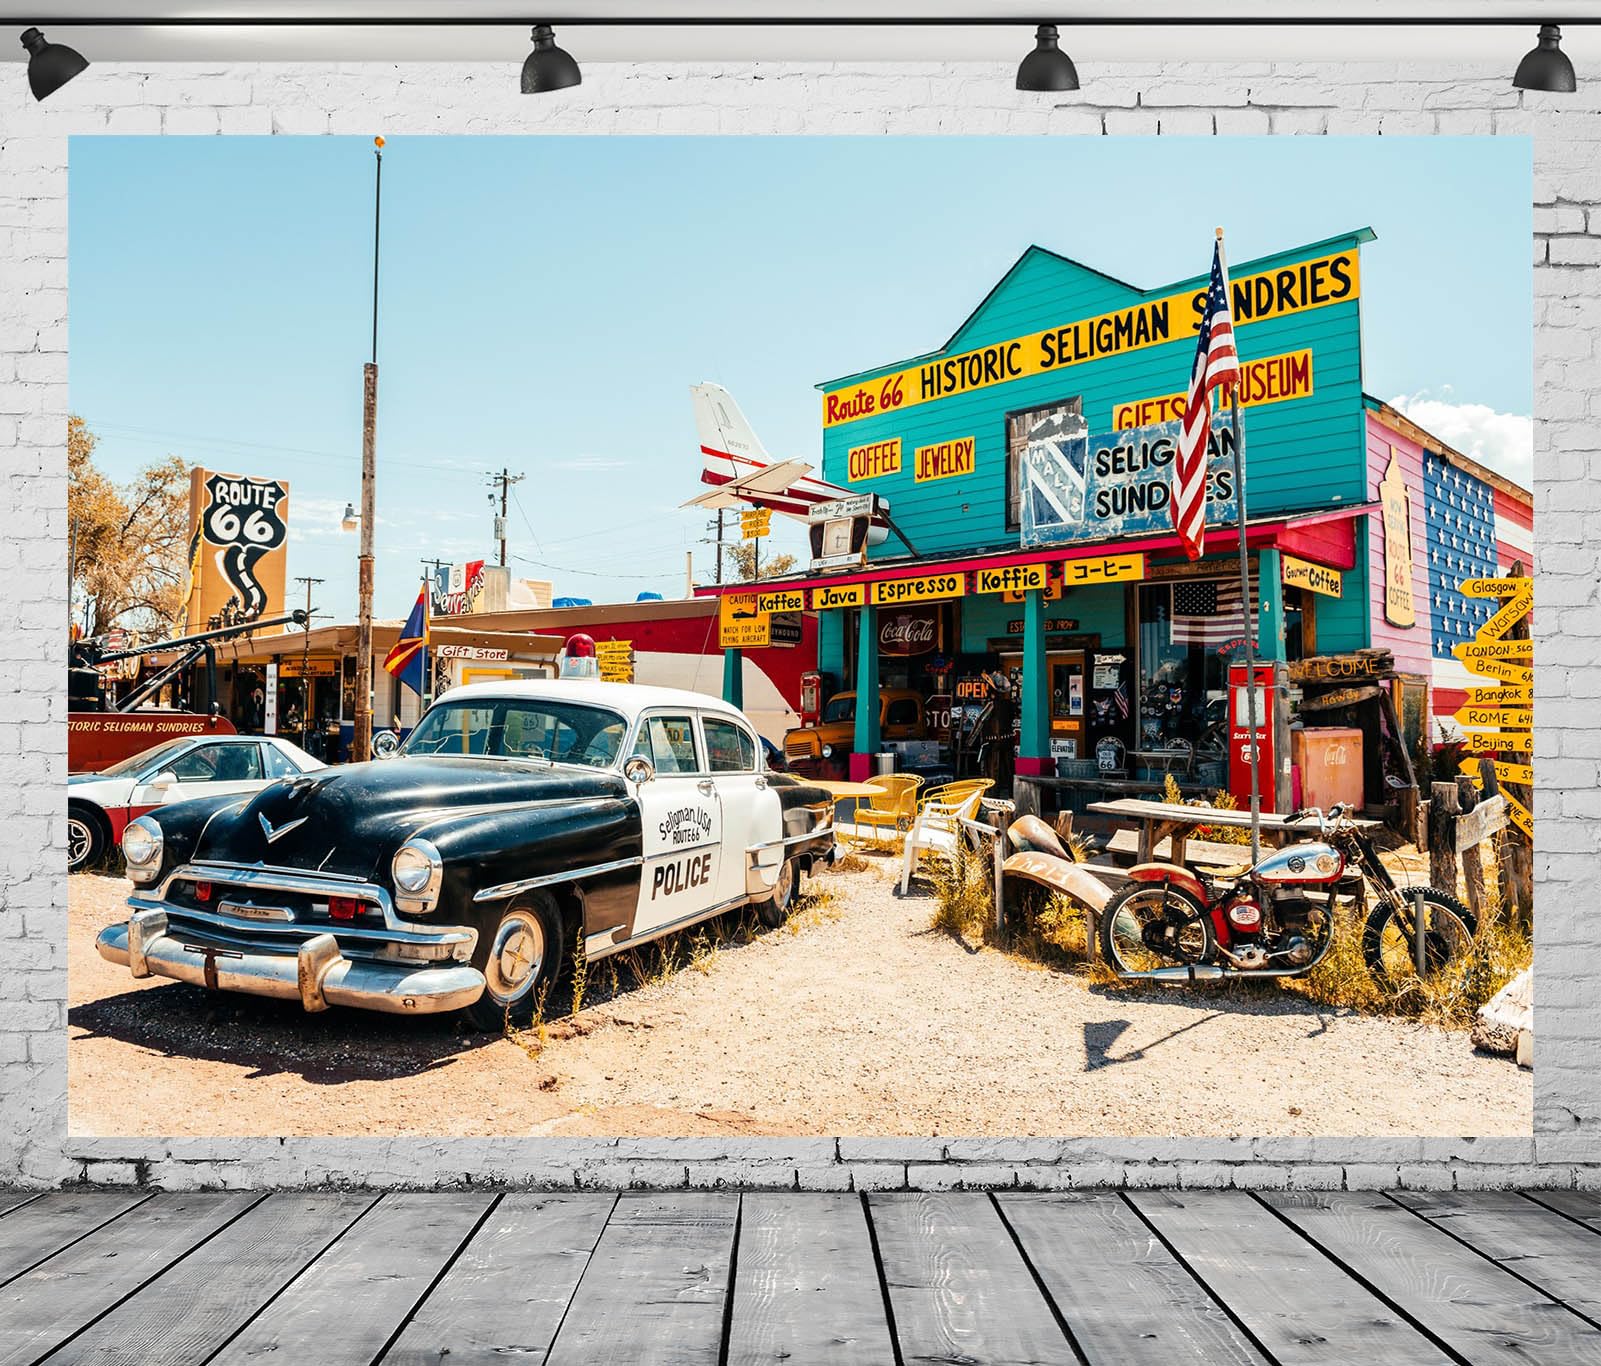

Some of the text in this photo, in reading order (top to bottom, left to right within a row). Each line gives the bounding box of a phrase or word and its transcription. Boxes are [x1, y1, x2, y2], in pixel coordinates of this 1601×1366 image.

[827, 256, 1352, 424] Route 66 HISTORIC SELIGMAN SNDRIES
[849, 441, 899, 479] COFFEE
[916, 440, 973, 480] JEWELRY
[1095, 427, 1237, 477] SELIGAN
[1031, 449, 1082, 513] MALTS
[215, 481, 276, 509] ROUTE
[210, 503, 274, 543] 66
[981, 568, 1040, 590] Koffie
[1074, 562, 1132, 580] コーヒー
[1309, 568, 1339, 593] Coffee
[1394, 564, 1404, 586] 66
[879, 576, 957, 602] Espresso
[1472, 580, 1517, 595] Glasgow
[729, 593, 757, 605] CAUTIO
[759, 593, 801, 611] Kaffee
[820, 588, 857, 607] Java
[1389, 586, 1410, 611] COFFEE
[1482, 593, 1533, 638] Warsaw
[723, 624, 765, 634] WATCH FOR LOW
[722, 635, 766, 644] FLYING AIRCRAFT
[442, 646, 507, 660] Gift Store
[1465, 645, 1511, 657] LONDON
[1291, 658, 1380, 678] WELCOME
[1476, 660, 1512, 677] Berlin
[957, 682, 990, 698] OPEN
[1321, 688, 1360, 705] Howdy
[1475, 688, 1522, 703] Bangkok
[1469, 710, 1510, 725] ROME
[103, 722, 154, 733] SELIGMAN
[156, 723, 205, 733] SUNDRIES
[1472, 734, 1514, 751] Beijing
[1100, 761, 1113, 769] 66
[696, 806, 712, 837] USA
[651, 853, 711, 901] POLICE
